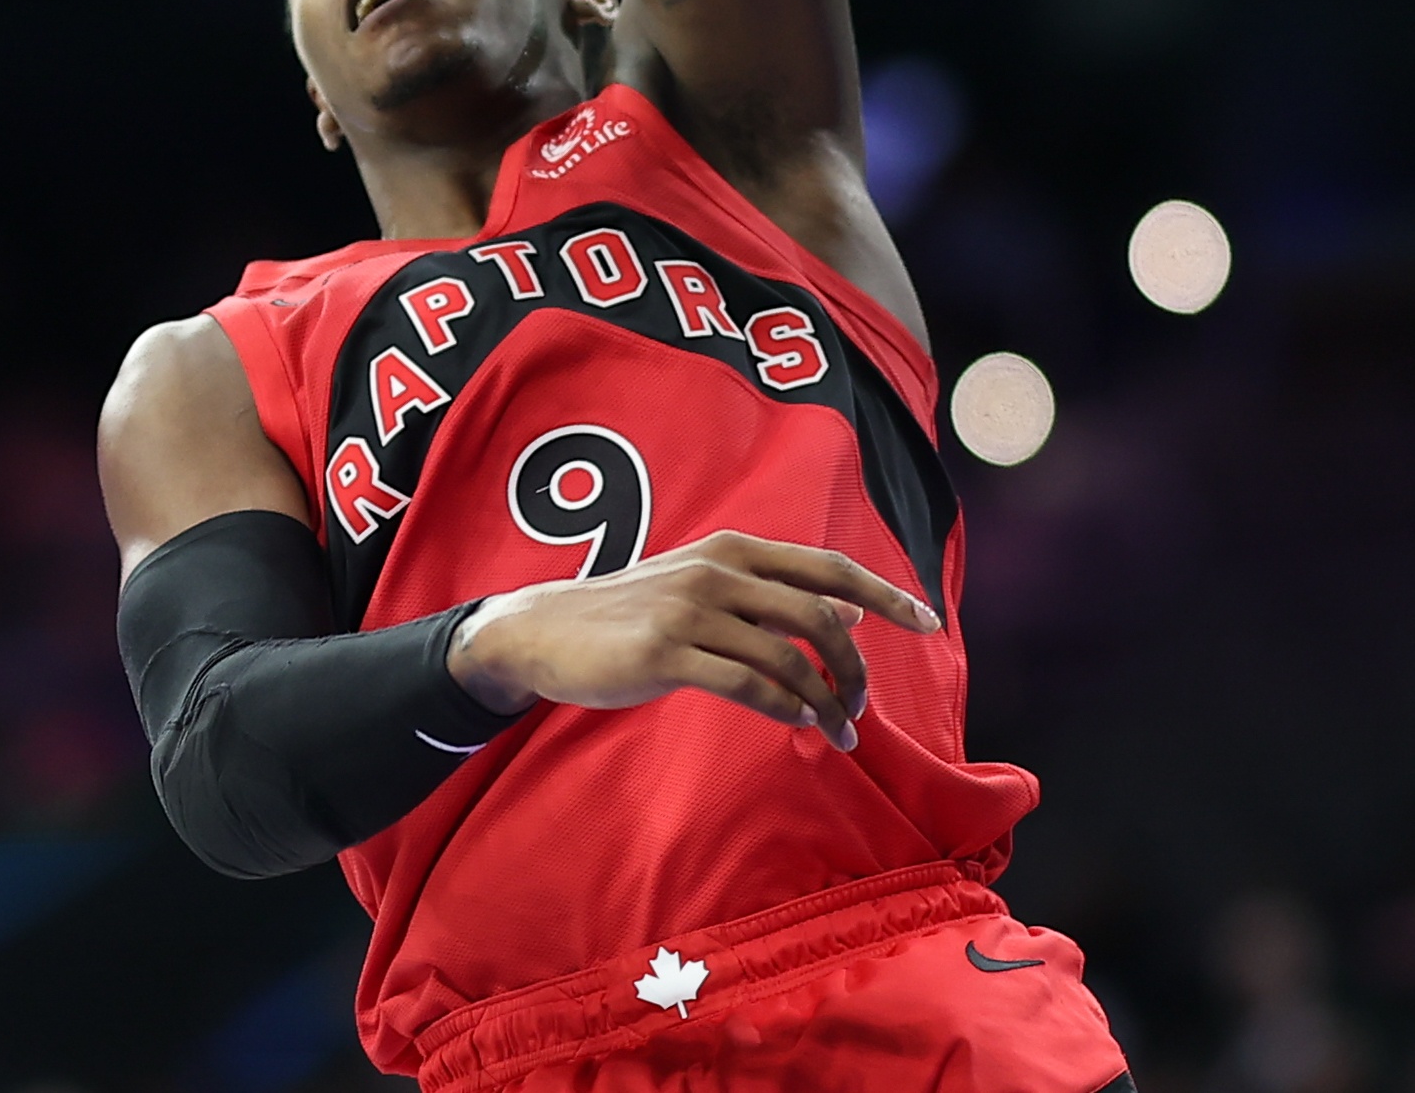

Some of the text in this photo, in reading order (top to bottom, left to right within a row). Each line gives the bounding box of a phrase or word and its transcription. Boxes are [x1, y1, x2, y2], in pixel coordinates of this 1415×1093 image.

[580, 120, 631, 154] Life
[325, 227, 829, 545] RAPTORS
[507, 423, 653, 580] 9
